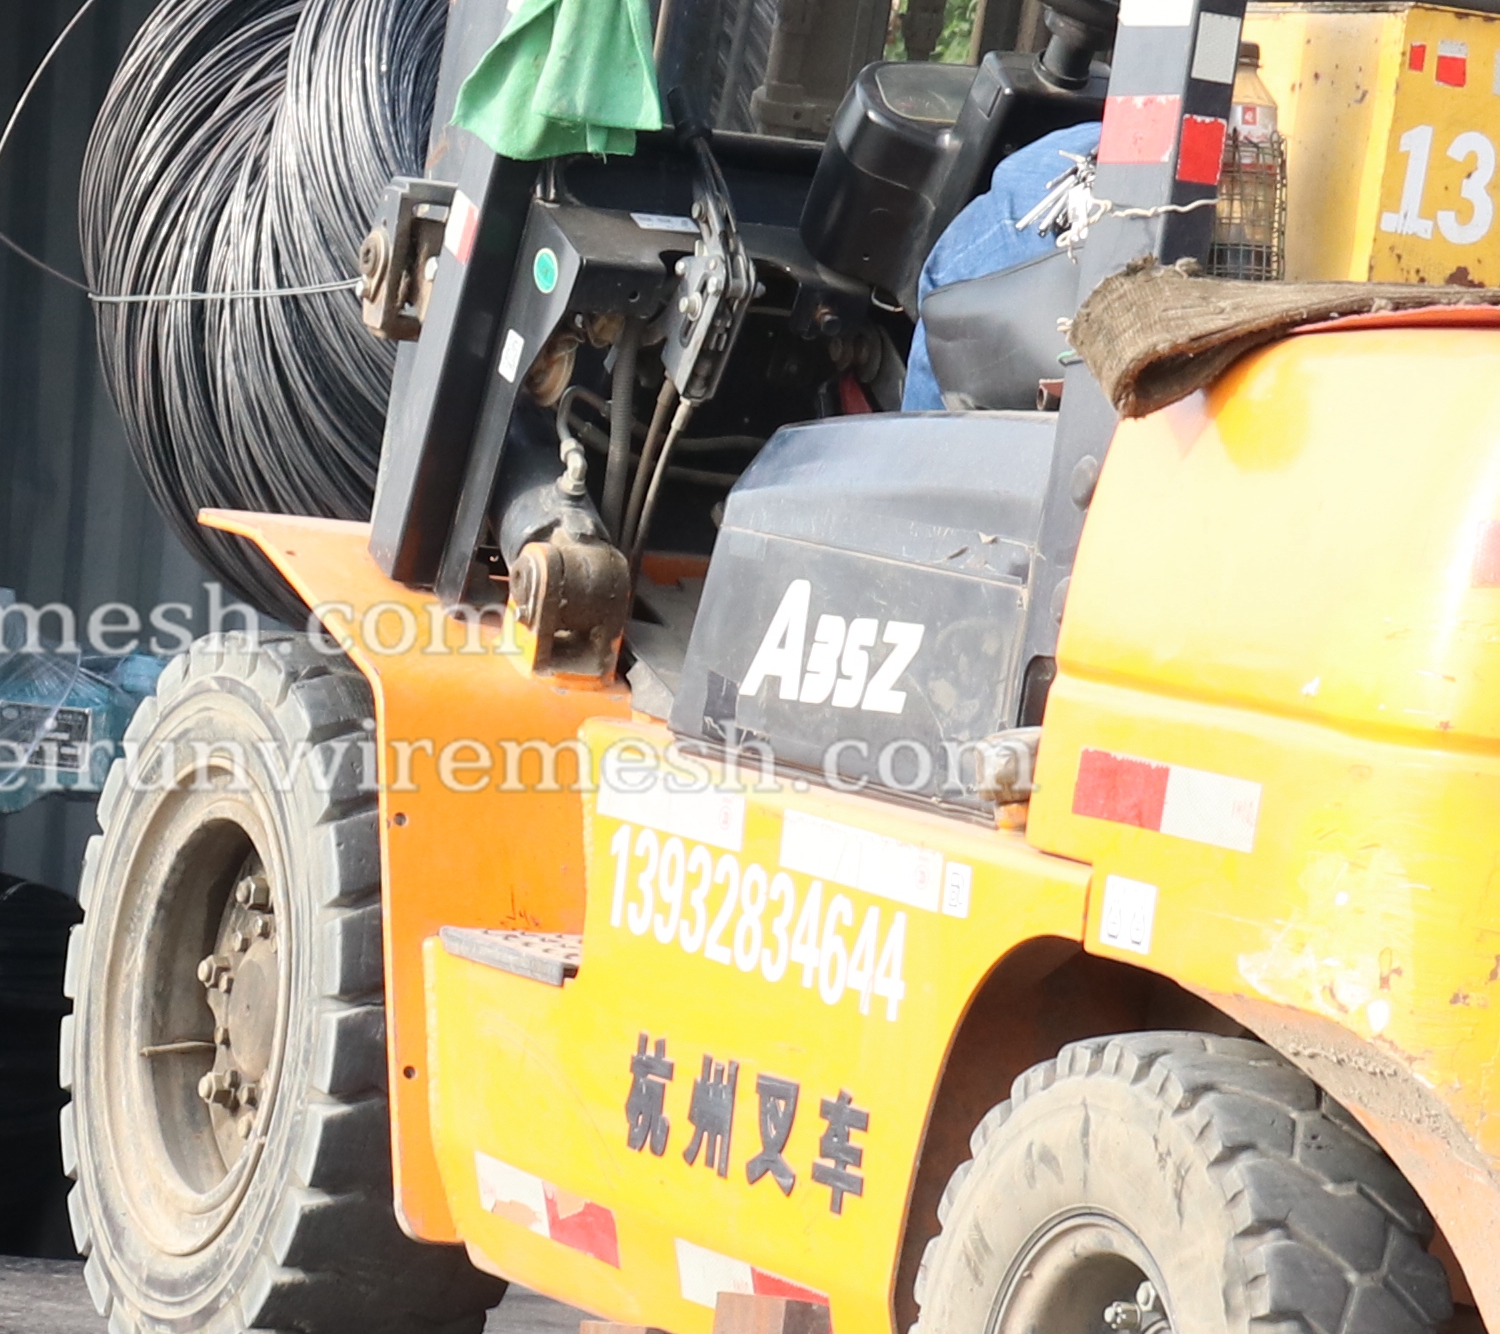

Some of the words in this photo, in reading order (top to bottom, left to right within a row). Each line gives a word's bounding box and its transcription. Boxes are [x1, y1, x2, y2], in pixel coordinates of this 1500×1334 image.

[608, 824, 908, 1023] 13932834644
[625, 1030, 870, 1216] 杭州叉车
